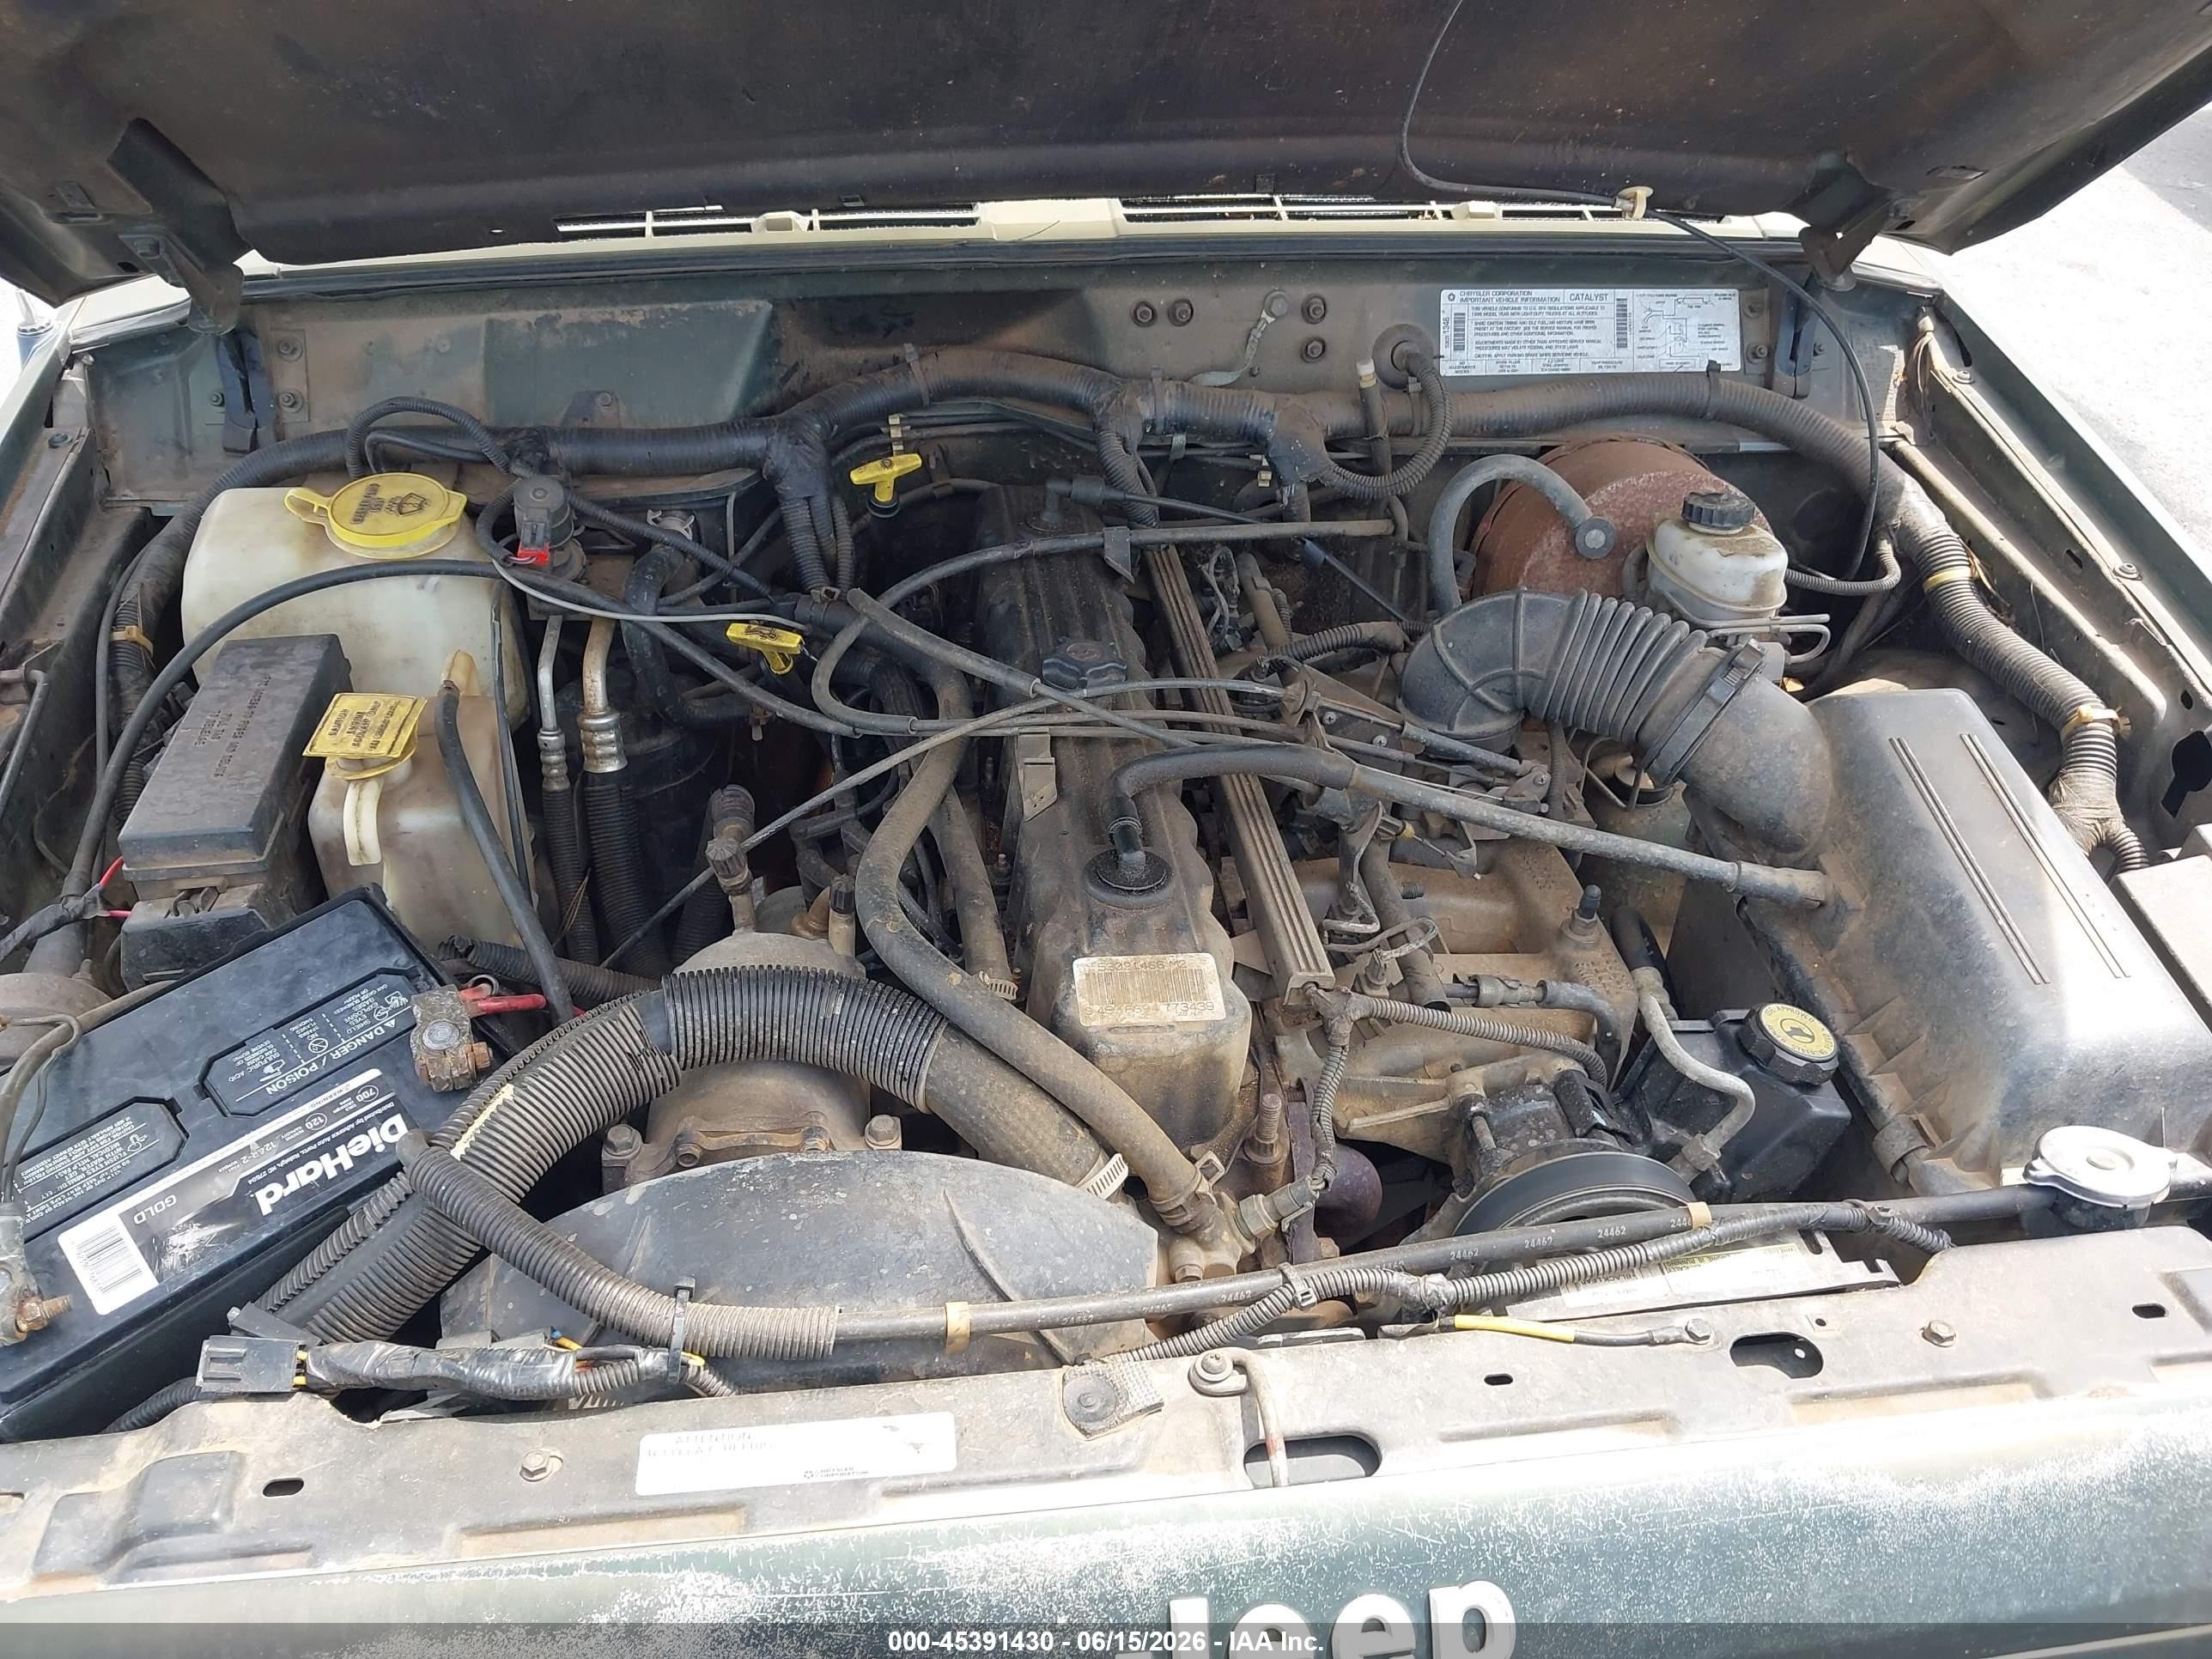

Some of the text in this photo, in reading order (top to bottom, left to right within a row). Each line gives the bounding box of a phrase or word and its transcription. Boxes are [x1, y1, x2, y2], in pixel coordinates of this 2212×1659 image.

[1569, 293, 1608, 301] CATALYST
[342, 1000, 379, 1024] EXPLOSIVE
[350, 995, 375, 1012] GASES
[344, 1017, 371, 1036] SHIELD
[348, 1012, 367, 1027] EYES
[305, 1030, 319, 1042] NO
[328, 1023, 385, 1061] DANGER
[227, 1049, 280, 1083] SULFURIC ACID
[264, 1060, 318, 1097] POISON
[355, 1086, 375, 1103] 700
[362, 1100, 395, 1121] Distributed
[303, 1114, 325, 1130] 120
[330, 1121, 356, 1139] Advance
[316, 1134, 331, 1146] Auto
[88, 1139, 120, 1160] MEDICAL
[103, 1145, 124, 1159] WITH
[70, 1156, 90, 1170] HELP
[102, 1150, 127, 1167] FLUSH
[251, 1109, 412, 1218] DieHard
[63, 1170, 78, 1182] GET
[84, 1162, 104, 1176] EYES
[131, 1191, 179, 1225] GOLD
[1597, 1225, 1627, 1239] 24462
[1523, 1235, 1553, 1249] 24462
[1449, 1247, 1480, 1261] 24462
[1116, 1580, 1516, 1659] Jeep
